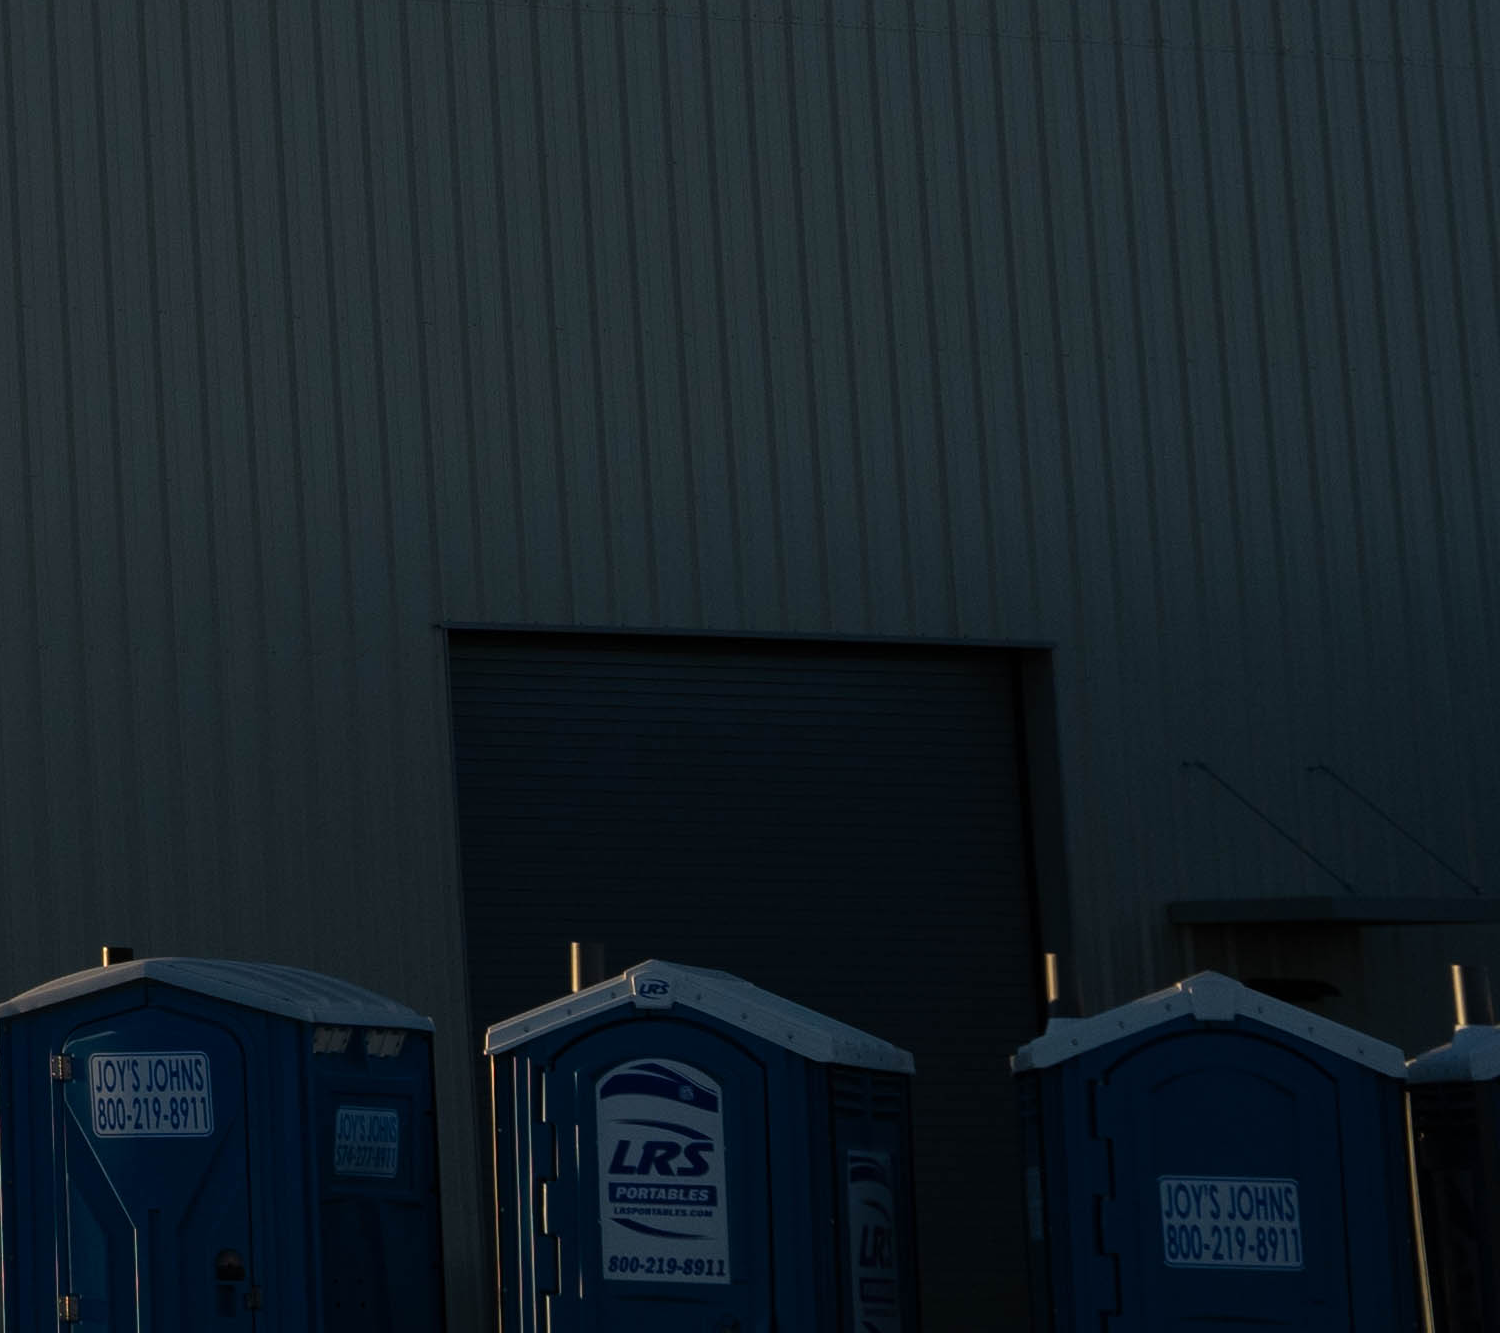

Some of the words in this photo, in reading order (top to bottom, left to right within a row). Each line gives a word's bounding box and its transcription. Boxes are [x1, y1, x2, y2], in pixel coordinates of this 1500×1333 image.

[640, 983, 669, 994] LRS
[96, 1059, 140, 1092] JOY'S
[146, 1059, 204, 1092] JOHNS
[98, 1097, 208, 1130] 800-219-8911
[609, 1139, 714, 1176] LRS
[615, 1186, 709, 1202] PORTABLES
[1165, 1184, 1220, 1219] JOY'S
[1228, 1185, 1295, 1221] JOHNS
[614, 1207, 714, 1218] LRSPORTABLES.COM
[1167, 1225, 1301, 1262] 800-219-8911
[608, 1255, 726, 1277] 800-219-8911
